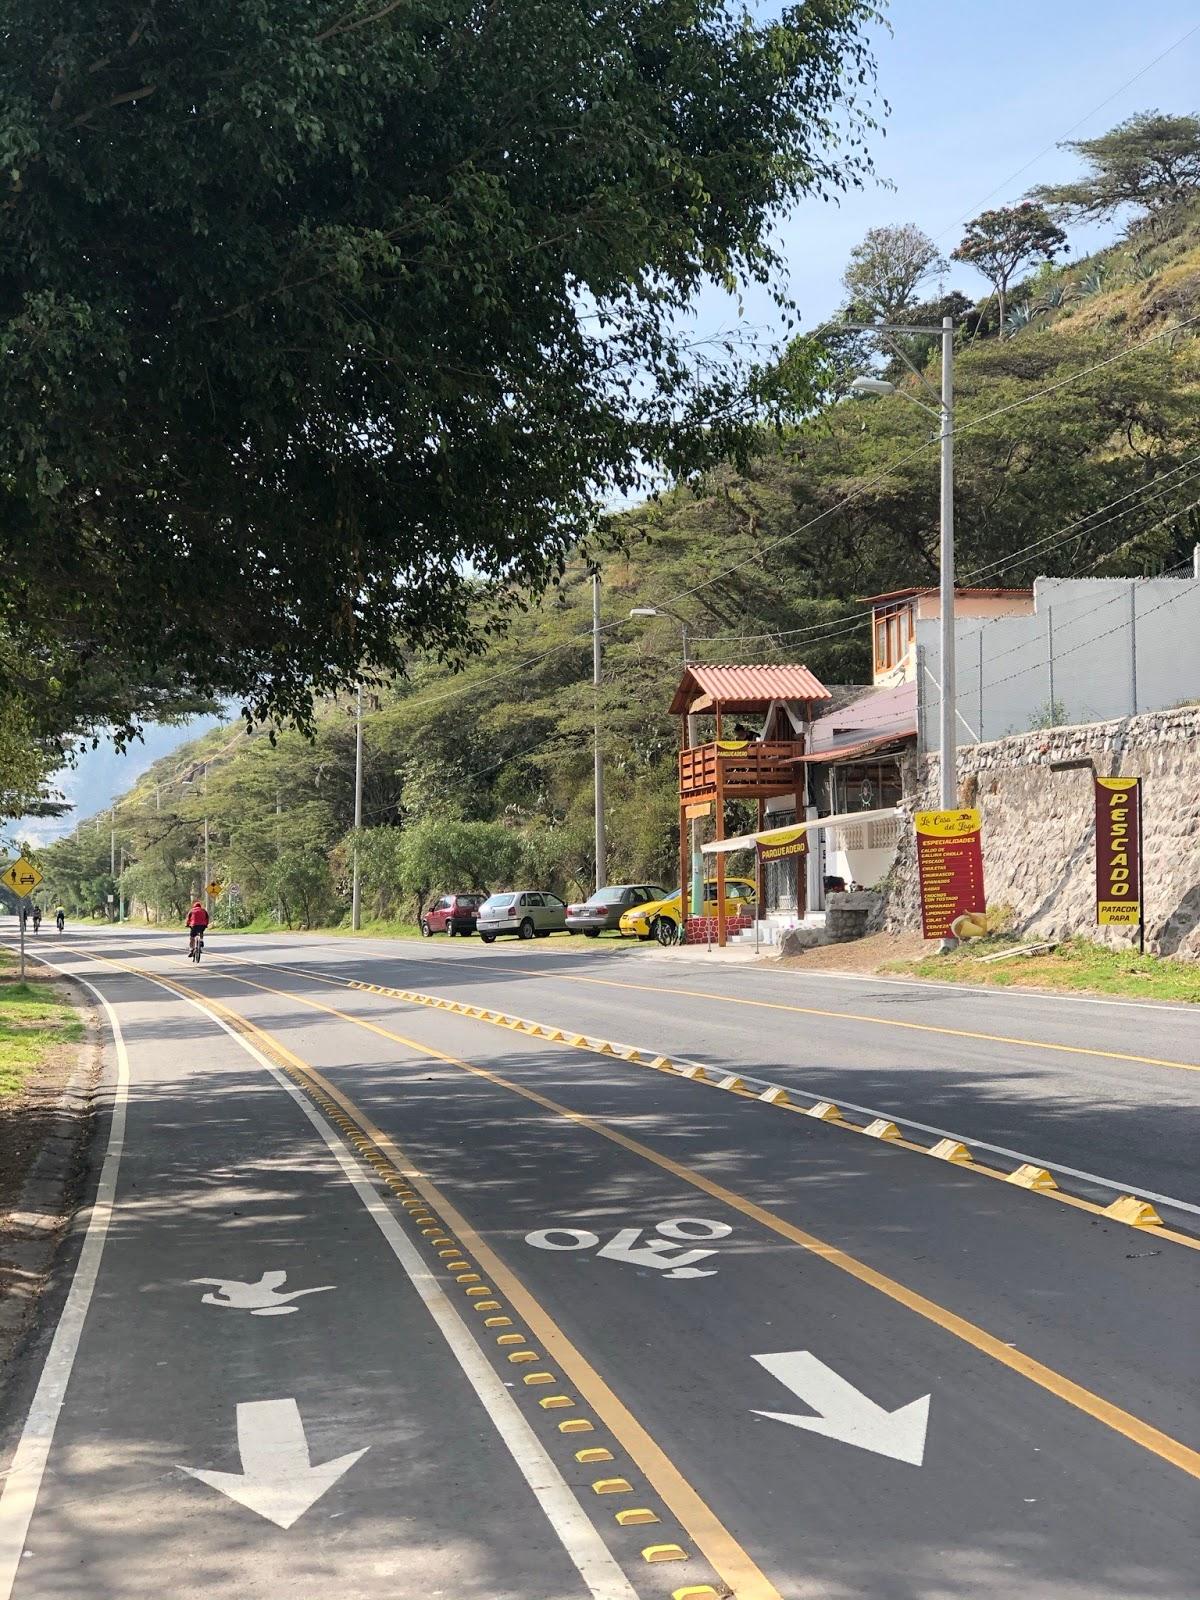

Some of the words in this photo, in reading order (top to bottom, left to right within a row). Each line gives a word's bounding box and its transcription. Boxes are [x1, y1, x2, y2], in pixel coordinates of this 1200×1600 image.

[920, 816, 930, 826] La
[933, 815, 951, 825] Casa
[957, 822, 974, 832] Lago
[922, 837, 976, 846] ESPECIALIDADES
[1109, 793, 1129, 896] PESCADO
[761, 843, 805, 859] PARQUEADERO
